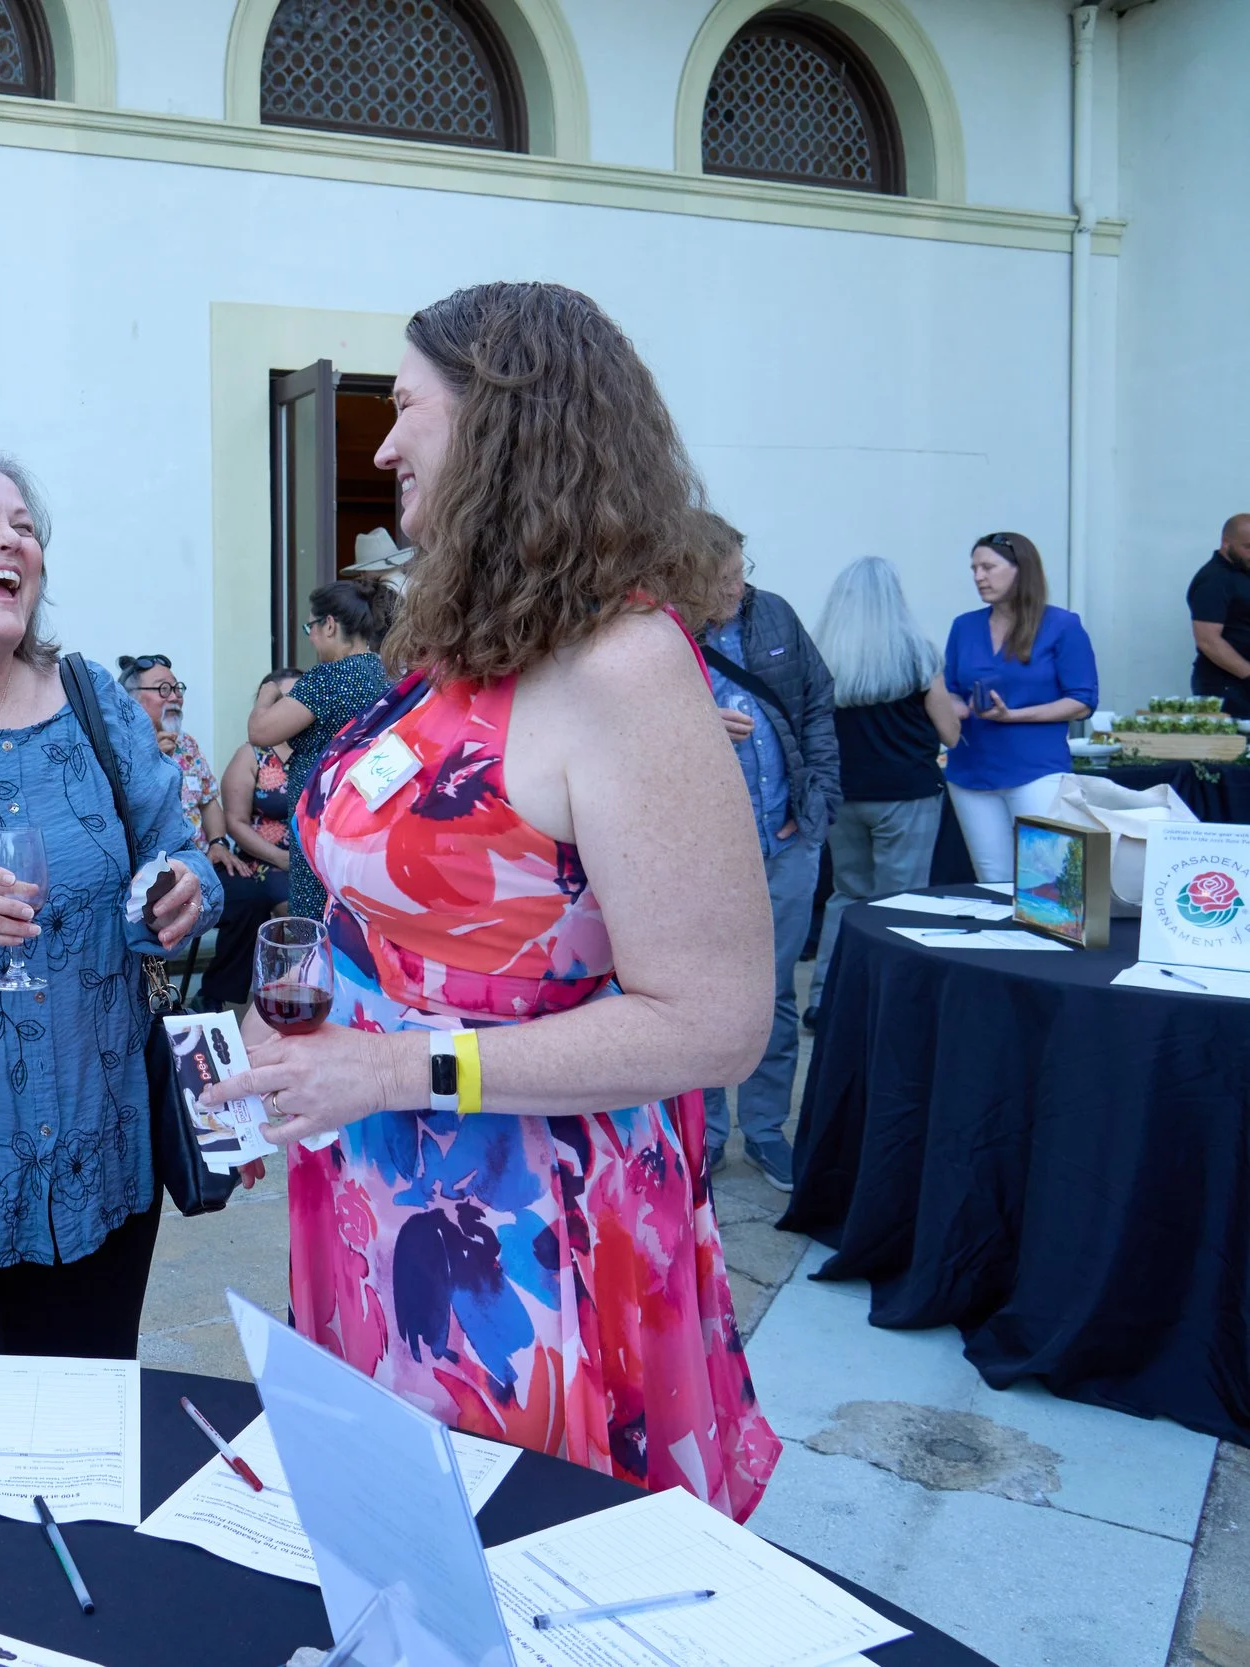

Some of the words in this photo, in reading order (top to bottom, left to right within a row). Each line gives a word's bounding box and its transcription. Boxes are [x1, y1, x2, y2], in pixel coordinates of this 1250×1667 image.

[1171, 855, 1250, 878] PASADENA
[1154, 880, 1225, 948] TOURNAMENT
[174, 1511, 221, 1527] Educational
[193, 1511, 226, 1526] Program
[222, 1524, 261, 1544] Pasadena
[227, 1520, 273, 1542] Enrichment
[263, 1541, 278, 1550] The
[275, 1540, 310, 1557] Summer
[515, 1637, 535, 1654] Life's
[535, 1654, 546, 1664] My
